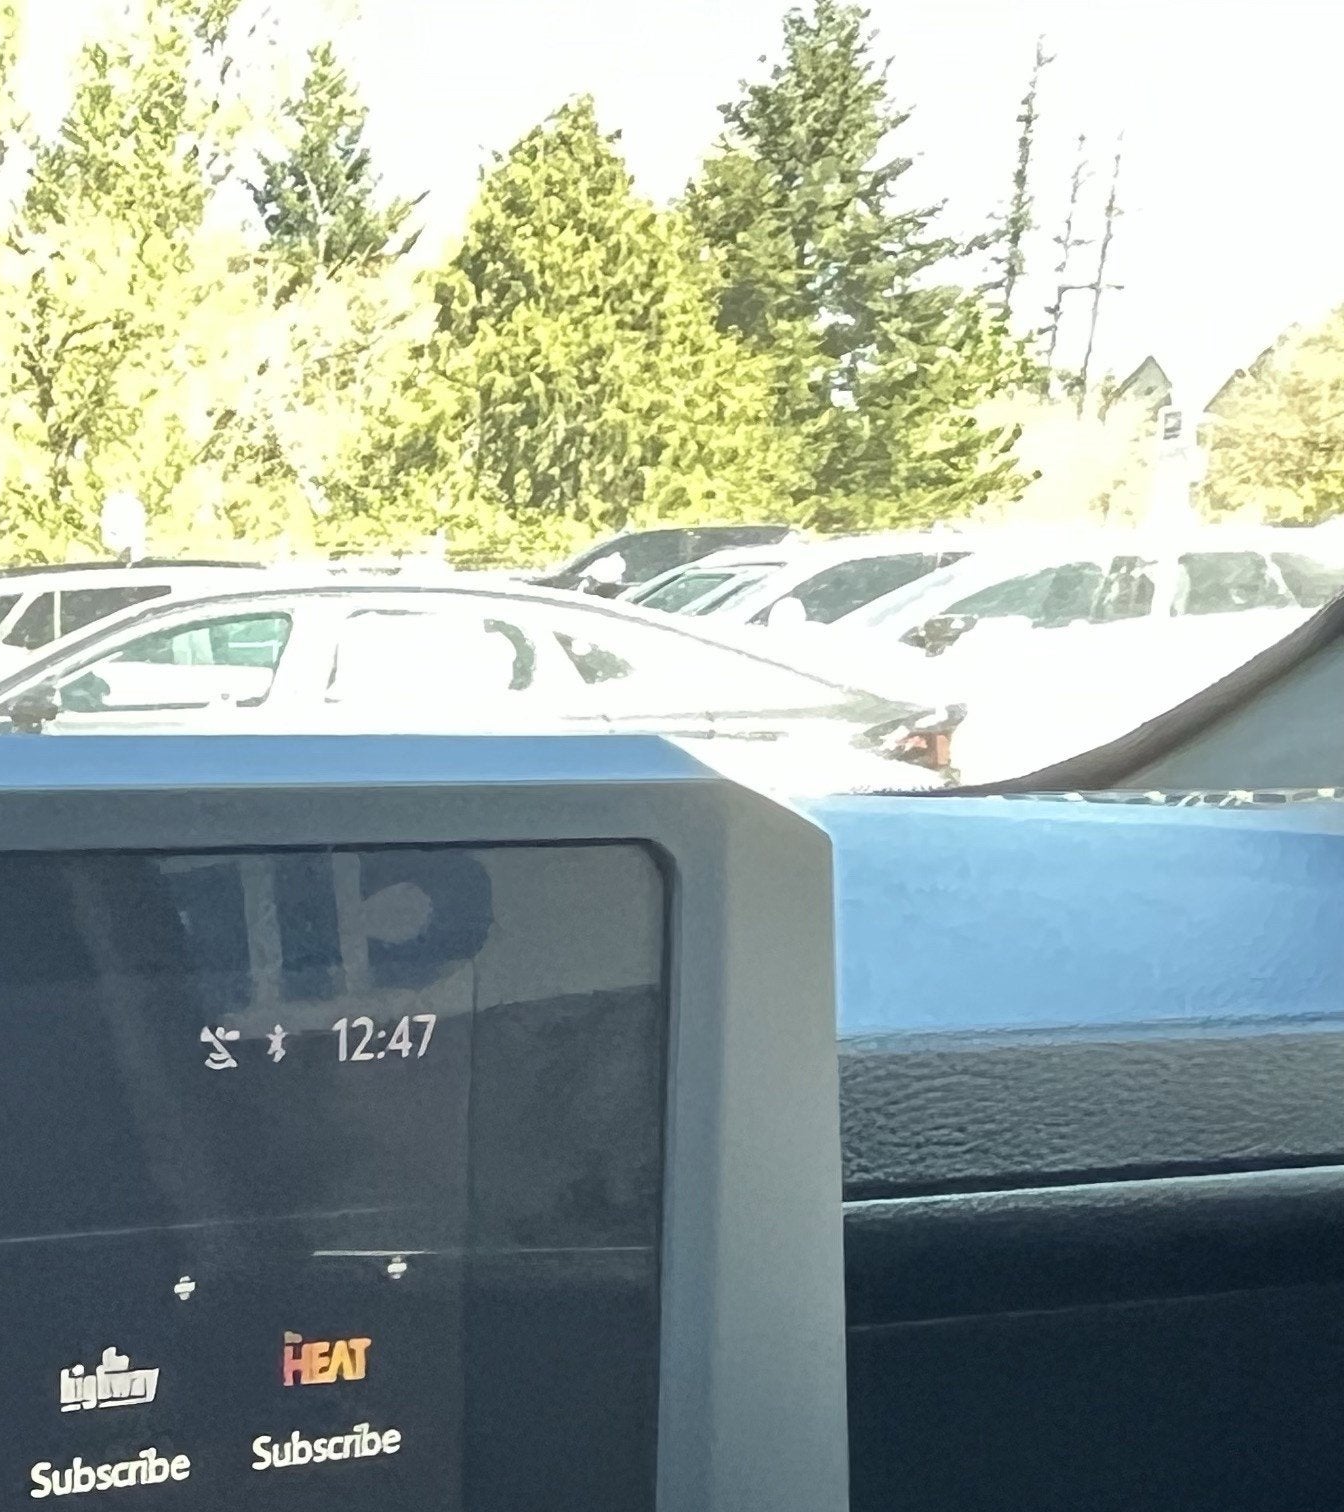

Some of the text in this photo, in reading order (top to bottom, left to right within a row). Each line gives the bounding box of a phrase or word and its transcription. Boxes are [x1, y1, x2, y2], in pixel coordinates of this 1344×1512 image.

[331, 1013, 437, 1062] 12:47
[283, 1337, 372, 1387] HEAT
[251, 1422, 402, 1471] Subscribe
[30, 1447, 191, 1499] Subscribe
